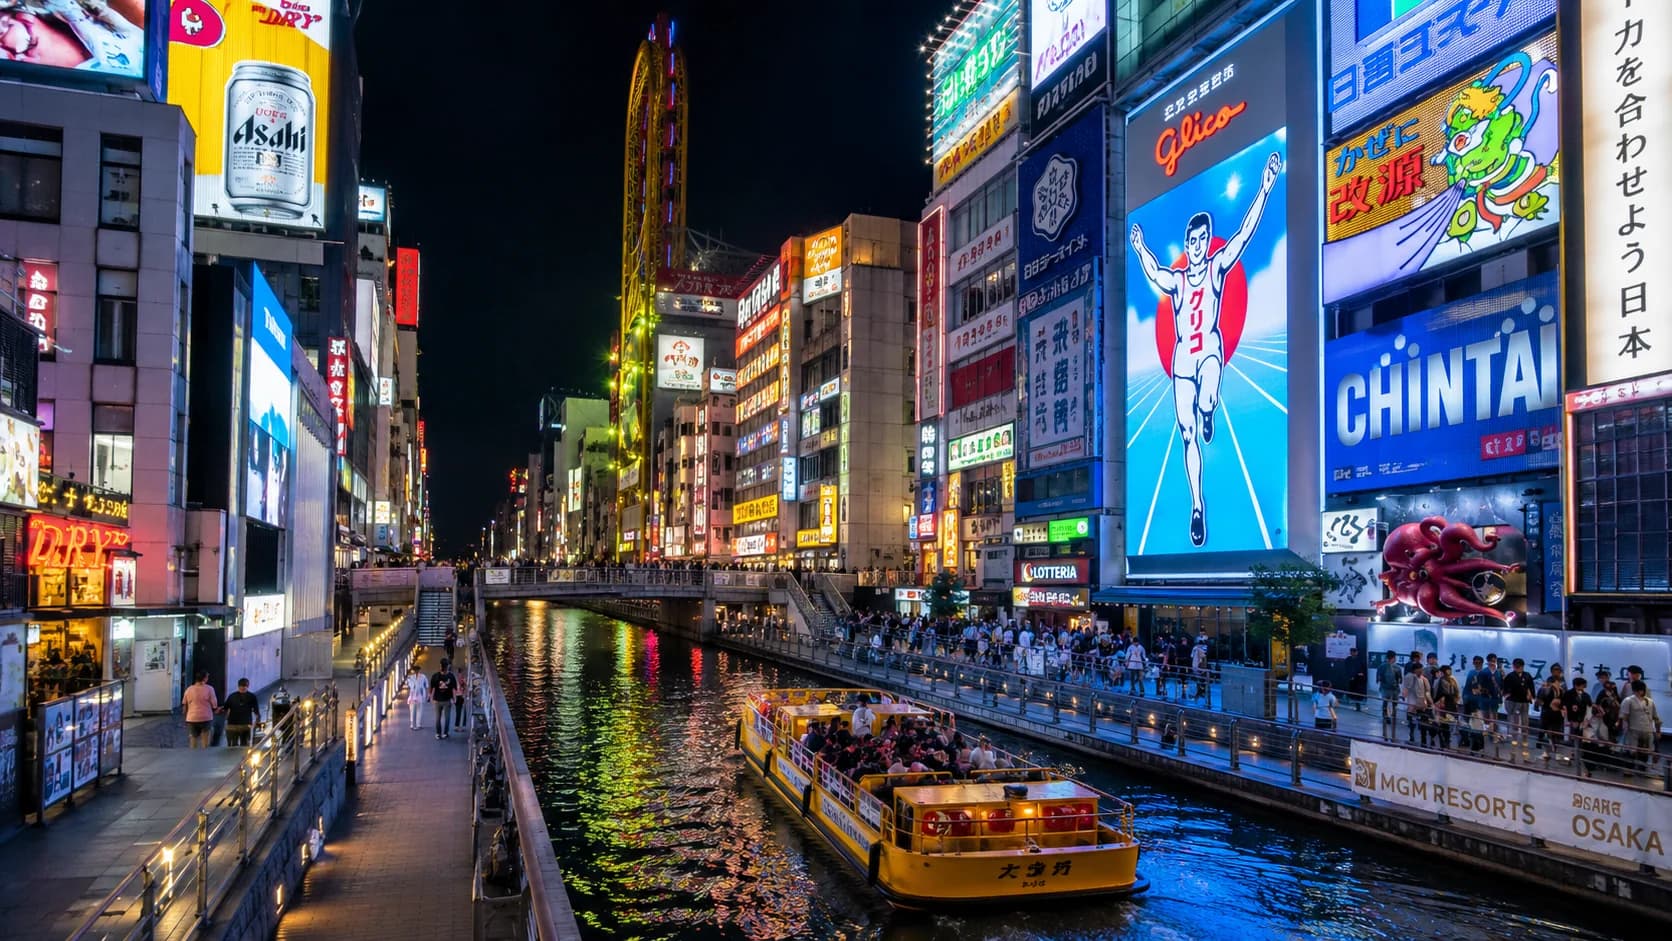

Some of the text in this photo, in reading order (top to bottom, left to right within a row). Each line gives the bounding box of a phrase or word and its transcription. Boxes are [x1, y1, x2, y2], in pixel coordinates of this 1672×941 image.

[233, 114, 306, 153] Asahi
[1155, 101, 1247, 176] Glico
[1335, 117, 1419, 177] かぜに
[1330, 145, 1425, 225] 改源
[1614, 0, 1652, 359] 力を合わせよう日本
[1189, 287, 1204, 354] グリコ
[1033, 565, 1077, 579] LOTTERIA
[1381, 773, 1427, 801] MGM
[1433, 784, 1536, 825] RESORTS
[1572, 815, 1664, 856] OSAKA
